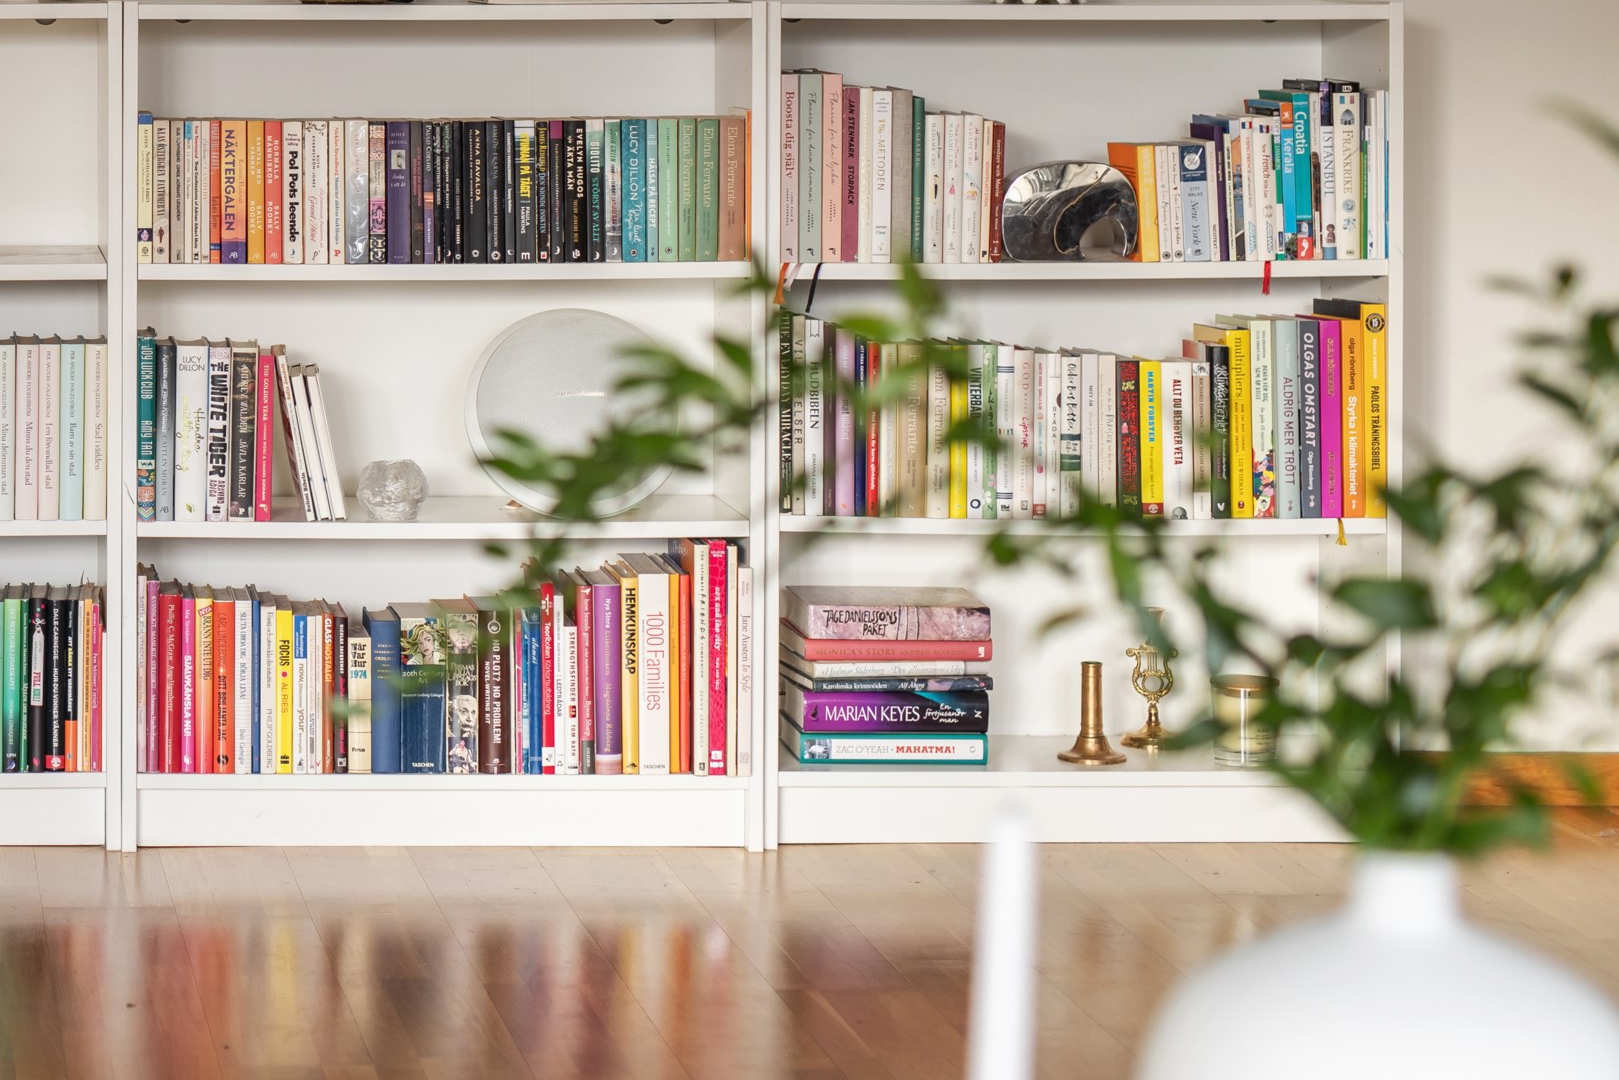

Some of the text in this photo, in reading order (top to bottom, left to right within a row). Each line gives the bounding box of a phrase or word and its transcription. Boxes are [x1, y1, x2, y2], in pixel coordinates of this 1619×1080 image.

[785, 91, 795, 129] Boosta
[727, 126, 738, 158] Elena
[783, 132, 795, 149] dig
[847, 99, 855, 206] JAN STENMARK STORPACK
[1295, 111, 1307, 155] Croatia
[567, 146, 575, 190] ÄKTA MÄN
[576, 128, 584, 198] EVELYN HUGOS
[629, 125, 638, 201] LUCY DILLON
[648, 158, 657, 184] HÄLSA
[784, 152, 795, 179] själv
[1283, 138, 1293, 174] Kerala
[1322, 130, 1334, 198] ISTANBUL
[1341, 130, 1354, 194] FRANKRIKE
[224, 129, 237, 231] NÄKTERGALEN
[289, 150, 299, 243] Pol Pots leende
[649, 186, 657, 197] PÅ
[727, 159, 737, 207] Ferrante
[1348, 337, 1356, 354] olga
[1172, 379, 1182, 396] ALLT
[1232, 337, 1247, 398] multipliers
[1348, 355, 1357, 390] rönnberg
[140, 346, 154, 455] JOY LUCK CLUB AMY TAN
[1172, 398, 1182, 409] DU
[1303, 333, 1316, 447] OLGAS OMSTART
[208, 362, 229, 479] THE WHITE TIGER
[1283, 377, 1296, 485] ALDRIG MER TRÖTT
[1347, 395, 1357, 429] Styrka
[1370, 385, 1382, 471] PAOLOS TRÄNINGSBIBEL
[0, 423, 9, 495] Mina drömmars stad
[1173, 446, 1183, 465] VETA
[1348, 436, 1358, 496] klimakteriet
[625, 587, 636, 675] HEMKUNSKAP
[740, 614, 751, 633] Jane
[862, 623, 889, 636] PAKET
[279, 639, 290, 666] FOCUS
[646, 611, 665, 711] 1000 Families
[741, 634, 751, 662] Austen
[52, 683, 58, 693] DU
[183, 654, 193, 737] SJÄLVKÄNSLA NU!
[281, 682, 288, 693] AL
[492, 639, 501, 744] NO PLOT? NO PROBLEM!
[740, 673, 750, 693] Style
[825, 705, 920, 722] MARIAN KEYES
[836, 746, 854, 754] ZAC
[896, 746, 956, 754] MAHATMA!
